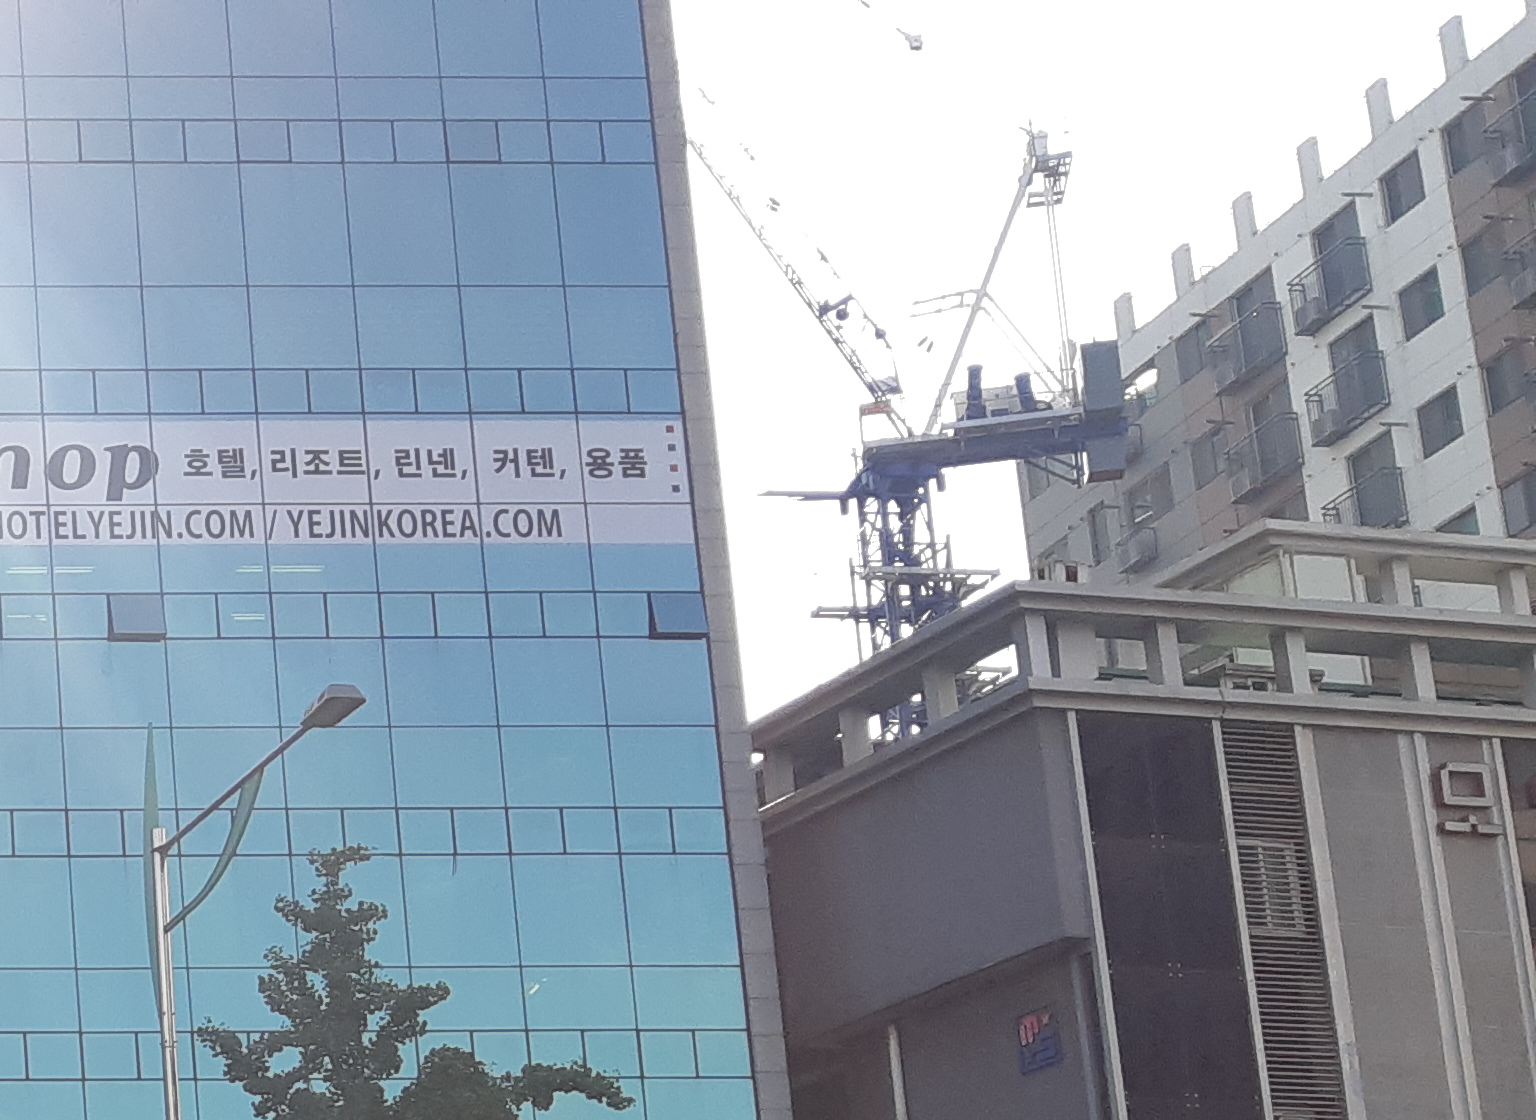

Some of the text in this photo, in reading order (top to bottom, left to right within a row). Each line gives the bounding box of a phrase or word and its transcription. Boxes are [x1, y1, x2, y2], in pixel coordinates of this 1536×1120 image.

[182, 447, 648, 482] 호텔, 리조트, 린넨, 커텐, 용품
[286, 509, 564, 541] YEJINKOREA.COM
